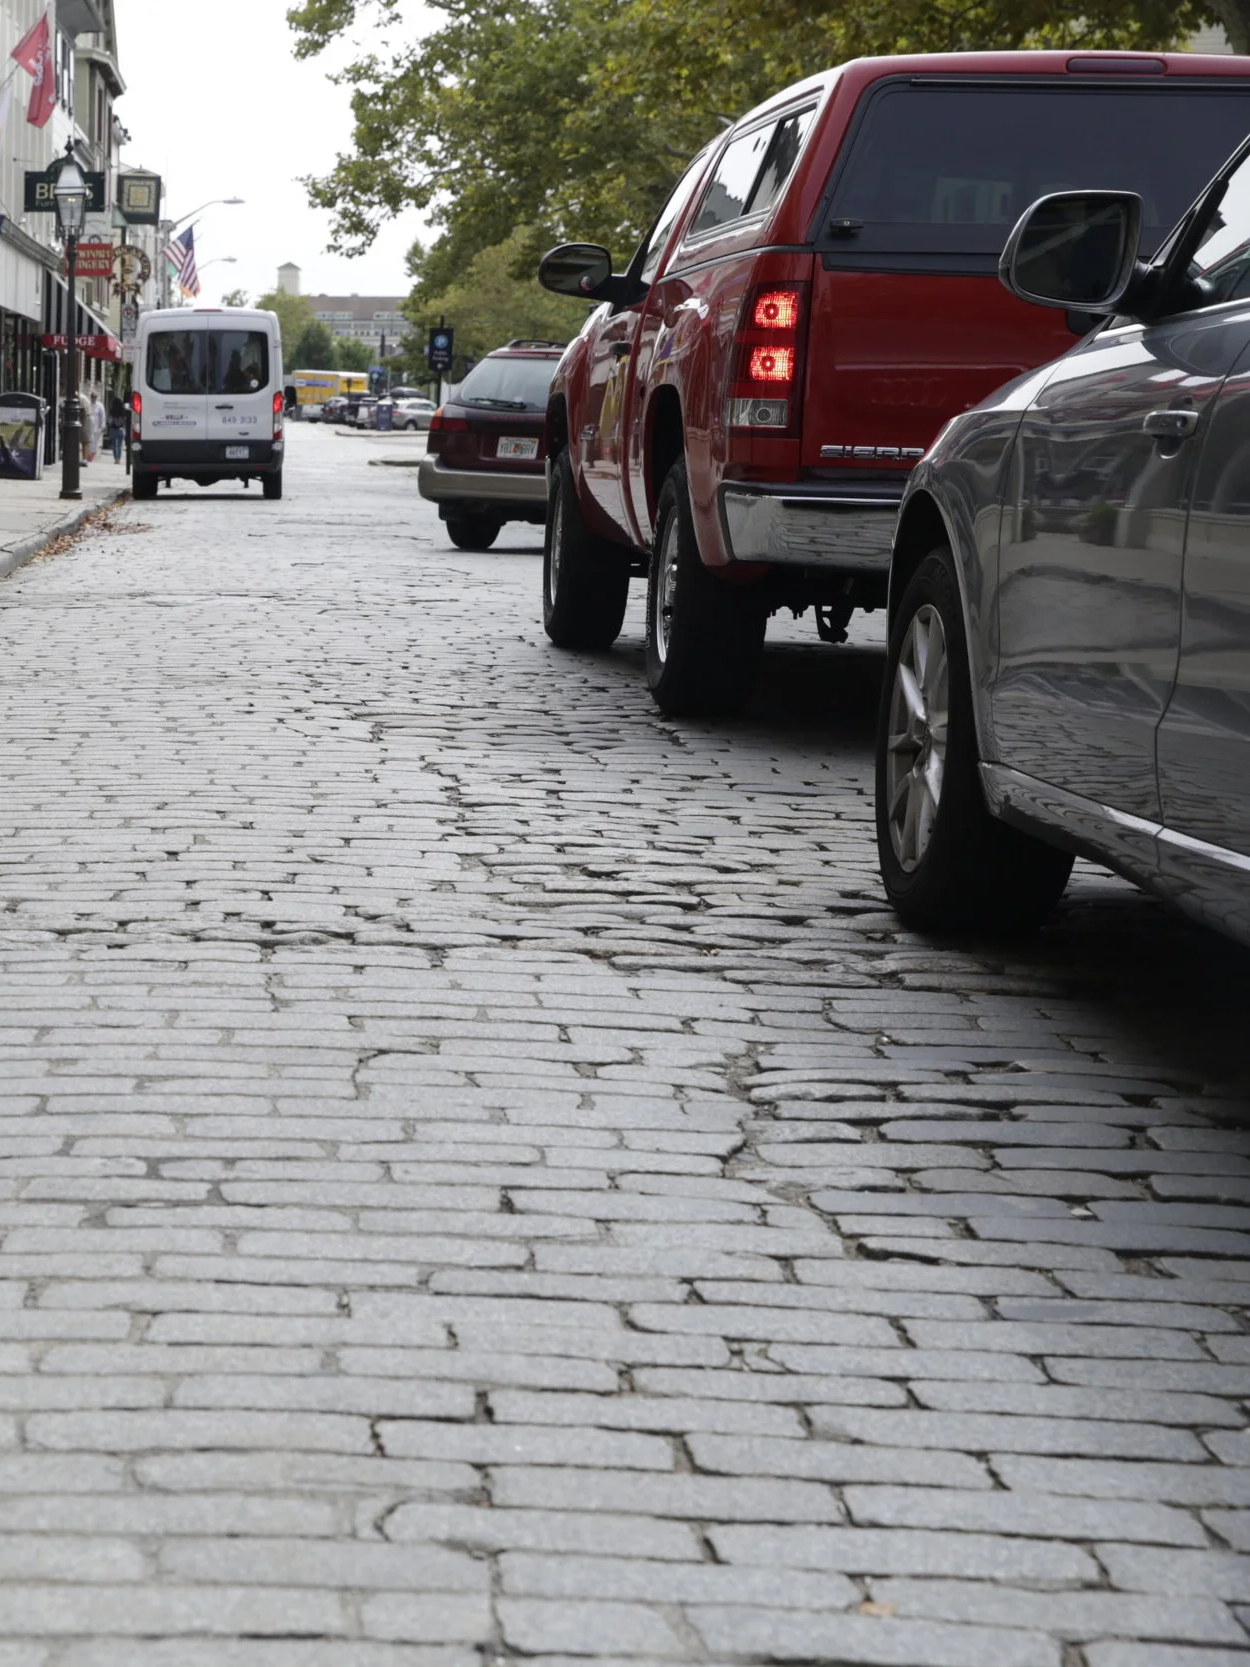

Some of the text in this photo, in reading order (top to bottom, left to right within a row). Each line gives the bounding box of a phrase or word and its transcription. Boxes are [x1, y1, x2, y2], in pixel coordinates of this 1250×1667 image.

[67, 249, 111, 259] WPORT
[66, 259, 111, 269] DGERY
[53, 335, 96, 346] FUGE
[820, 445, 925, 459] SIERR
